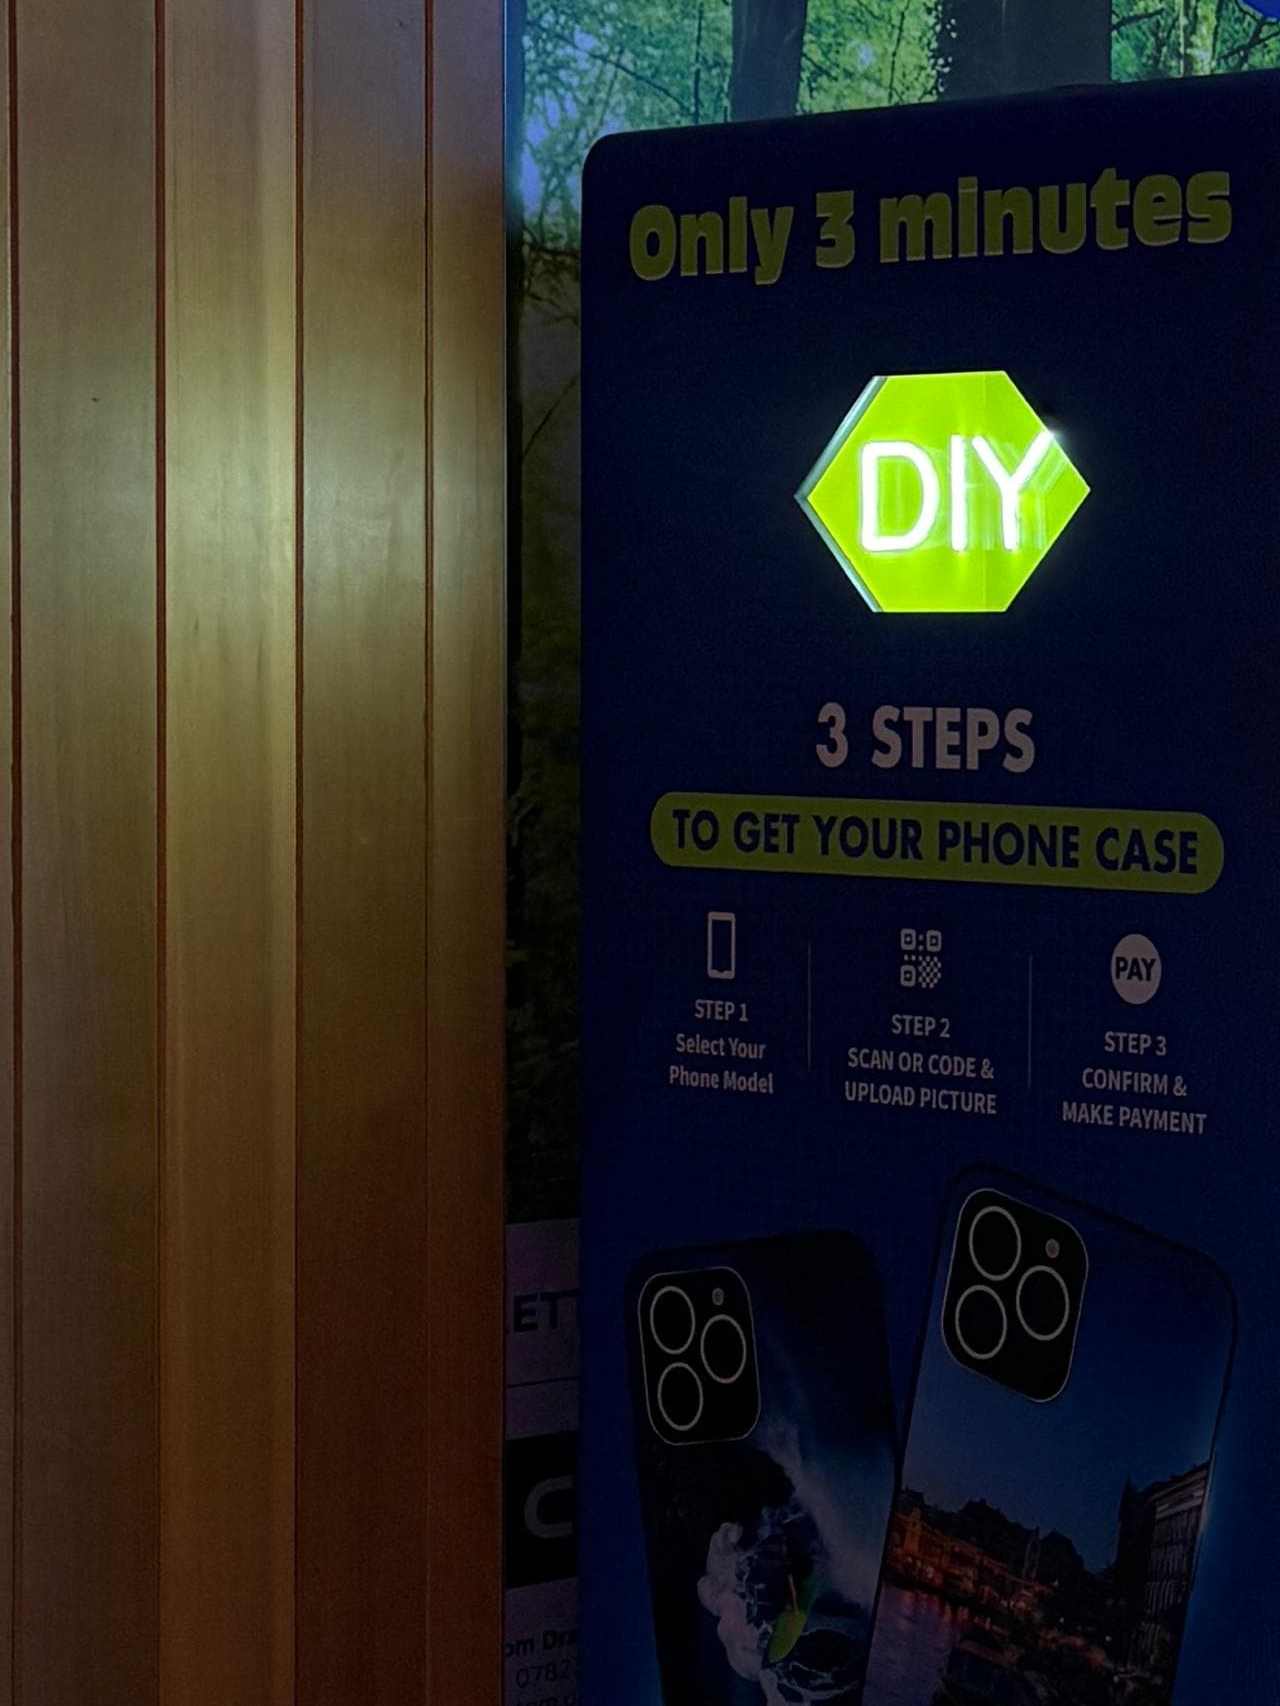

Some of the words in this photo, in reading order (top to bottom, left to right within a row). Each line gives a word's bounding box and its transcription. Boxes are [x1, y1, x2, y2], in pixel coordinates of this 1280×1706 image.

[629, 196, 794, 284] Only
[815, 191, 855, 269] 3
[879, 168, 1232, 263] minutes
[859, 430, 1054, 553] DIY
[815, 702, 849, 769] 3
[872, 705, 1036, 773] STEPS
[672, 808, 720, 853] TO
[733, 810, 800, 857] GET
[812, 815, 923, 862] YOUR
[938, 822, 1080, 870] PHONE
[1095, 828, 1199, 875] CASE
[1115, 956, 1156, 981] PAY
[694, 999, 735, 1021] STEP
[738, 1002, 749, 1022] 1
[891, 1014, 936, 1036] STEP
[939, 1017, 950, 1038] 2
[675, 1032, 726, 1057] Select
[728, 1037, 767, 1060] Your
[1103, 1031, 1152, 1055] STEP
[1155, 1035, 1168, 1056] 3
[847, 1047, 895, 1071] SCAN
[927, 1054, 977, 1077] CODE
[980, 1057, 995, 1079] &
[669, 1064, 720, 1089] Phone
[722, 1070, 774, 1095] Model
[1081, 1067, 1169, 1096] CONFIRM
[1172, 1075, 1187, 1097] &
[844, 1081, 916, 1106] UPLOAD
[919, 1087, 998, 1115] PICTURE
[1061, 1101, 1115, 1126] MAKE
[1119, 1105, 1208, 1135] PAYMENT
